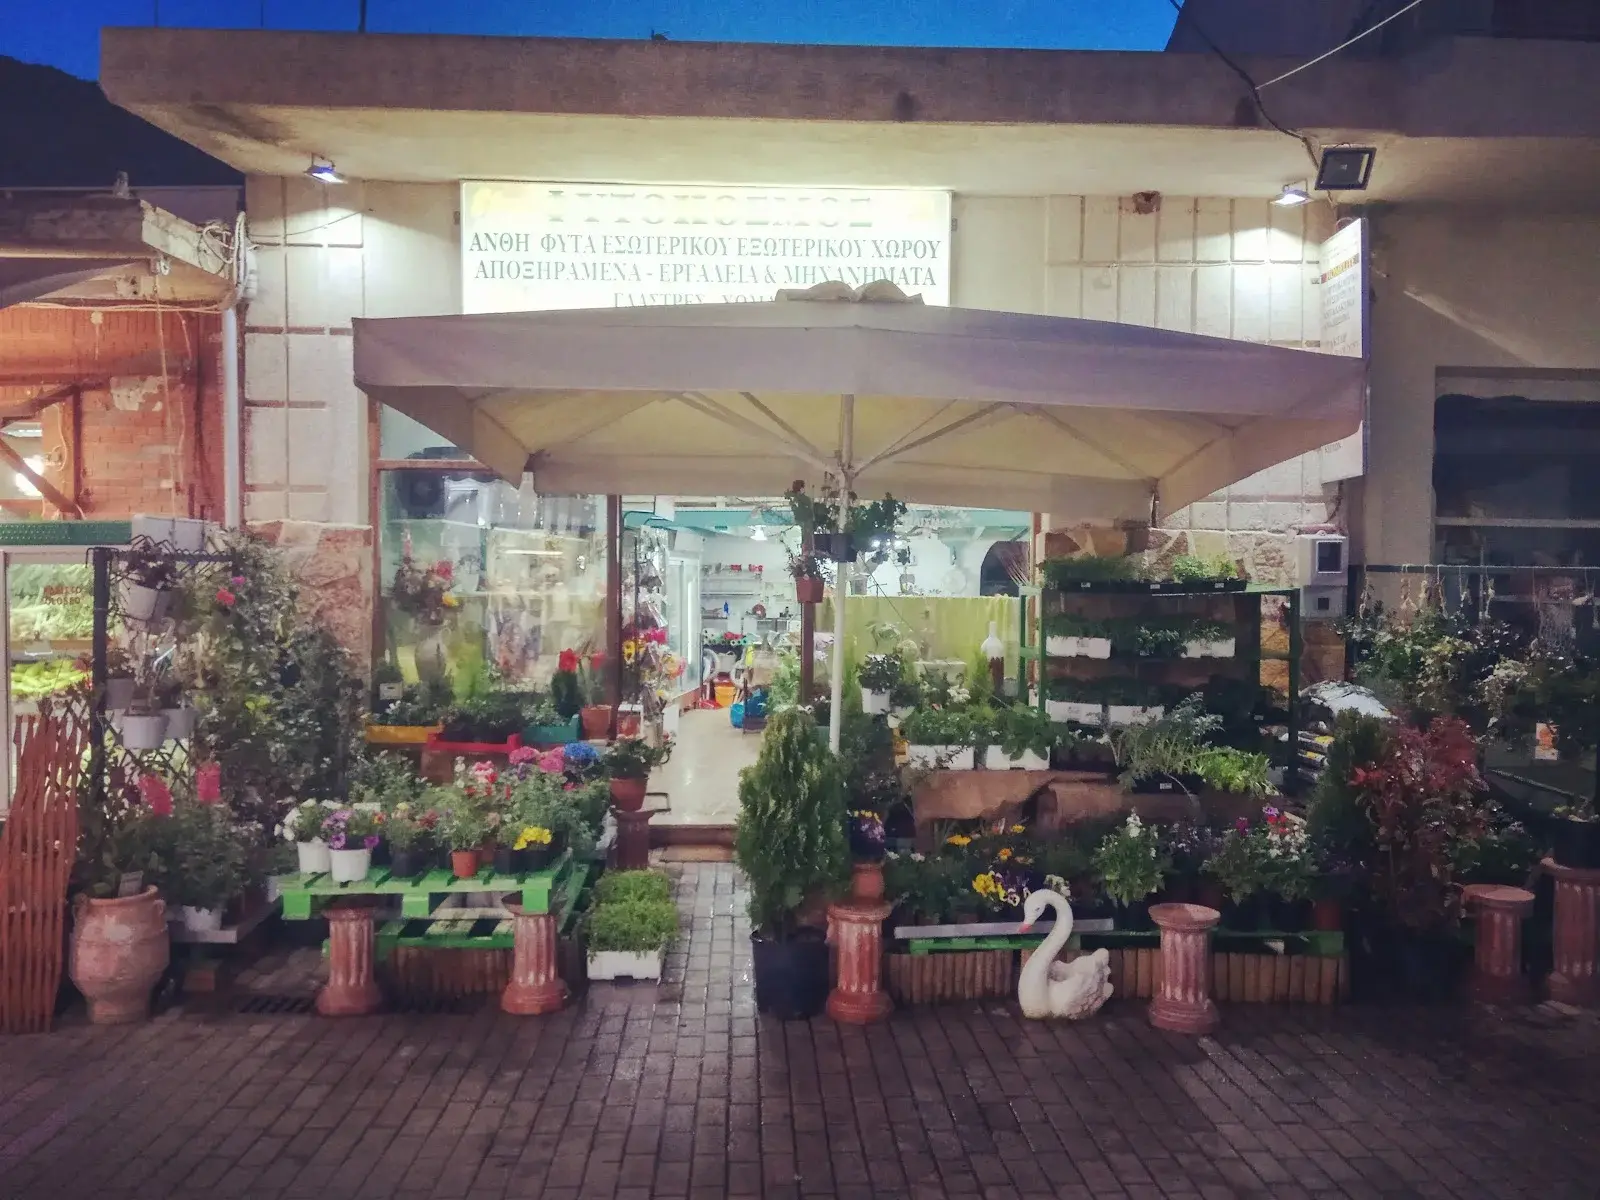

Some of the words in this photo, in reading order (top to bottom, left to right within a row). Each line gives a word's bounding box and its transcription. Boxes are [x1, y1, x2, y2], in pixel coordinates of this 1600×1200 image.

[468, 232, 530, 253] ΑΝΘΗ
[540, 233, 597, 254] ΦΥΤΑ
[603, 235, 732, 257] ΕΣΩΤΕΡΙΚΟΥ
[737, 237, 866, 259] ΕΞΩΤΕΡΙΚΟΥ
[871, 239, 942, 260] ΧΩΡΟΥ
[474, 261, 642, 282] ΑΠΟΞΗΡΑΜΕΝΑ
[659, 263, 758, 283] ΕΡΓΑΛΕΙΑ
[764, 265, 778, 284] &
